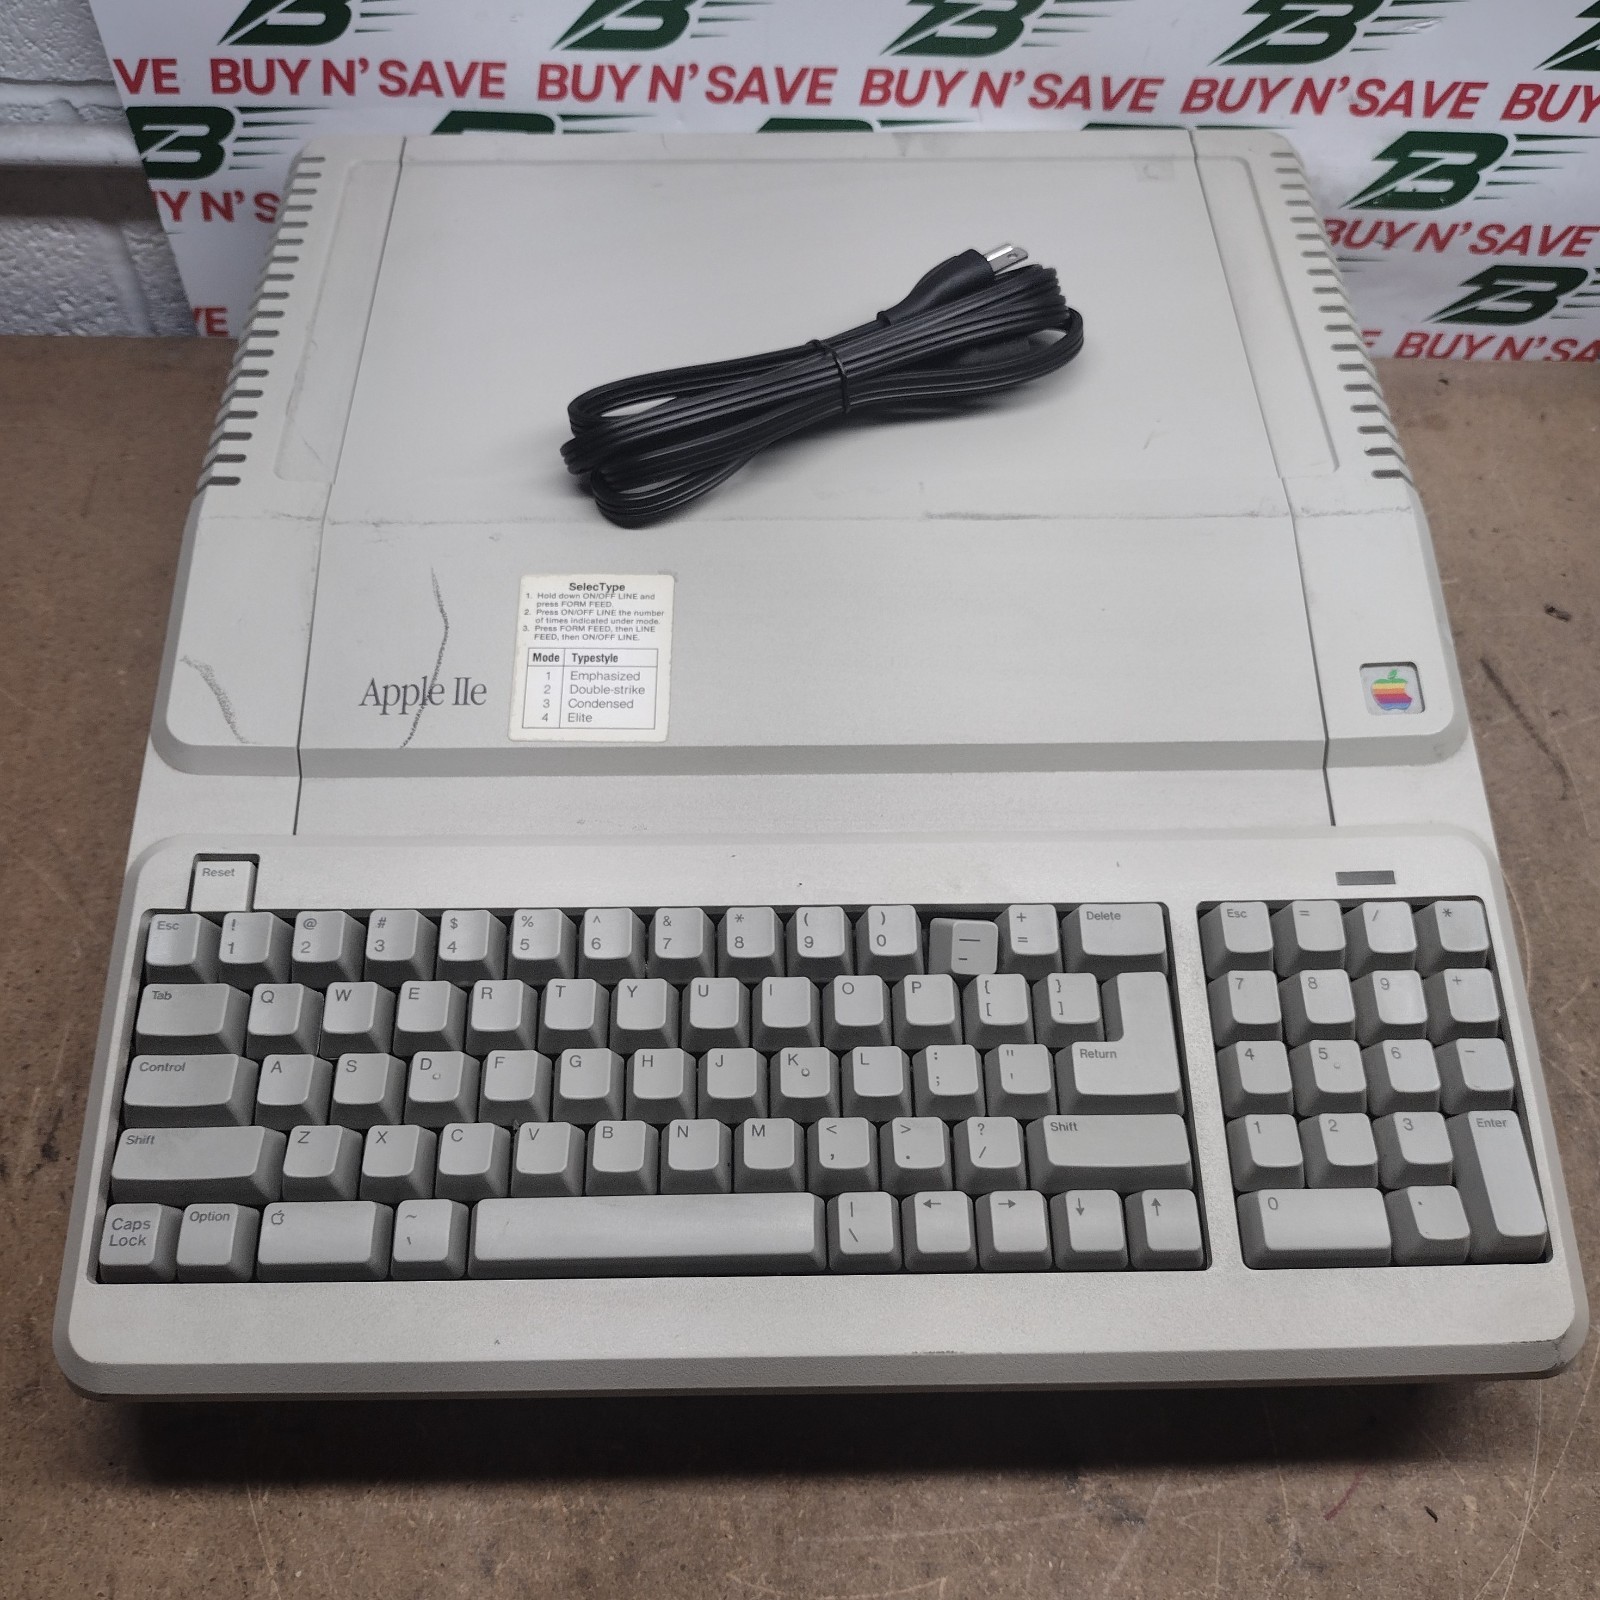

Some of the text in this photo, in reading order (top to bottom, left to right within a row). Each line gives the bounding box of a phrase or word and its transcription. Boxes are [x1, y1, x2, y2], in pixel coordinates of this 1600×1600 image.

[210, 58, 310, 95] BUY
[537, 64, 639, 102] BUY
[860, 68, 966, 107] BUY
[1179, 77, 1293, 114] BUY
[1393, 331, 1496, 361] BUY
[569, 582, 626, 594] SelecType
[532, 653, 618, 664] Mode Typestyle
[545, 671, 640, 683] 1 Emphasized
[358, 676, 445, 715] Apple
[544, 684, 645, 695] 2 Double-strike
[543, 699, 634, 709] 3 Condensed
[541, 713, 593, 722] 4 Elite
[202, 868, 234, 877] Reset
[1086, 911, 1121, 920] Delete
[1227, 909, 1247, 918] Esc
[156, 920, 180, 931] Esc
[303, 918, 317, 930] @
[378, 917, 386, 928] #
[450, 917, 458, 929] $
[522, 916, 534, 927] %
[663, 916, 671, 926] &
[375, 940, 385, 952] 3
[520, 939, 529, 950] 5
[591, 938, 601, 950] 6
[663, 938, 672, 949] 7
[735, 936, 744, 948] 8
[804, 936, 814, 948] 9
[877, 934, 886, 947] 0
[227, 942, 235, 954] 1
[301, 941, 311, 953] 2
[447, 941, 457, 953] 4
[912, 981, 921, 993] P
[1235, 978, 1243, 989] 7
[1308, 977, 1318, 989] 8
[1380, 978, 1390, 990] 9
[152, 991, 172, 1000] Tab
[261, 990, 274, 1003] Q
[336, 989, 352, 1001] W
[409, 987, 420, 1000] E
[481, 987, 492, 999] R
[556, 985, 566, 997] T
[627, 986, 637, 997] Y
[699, 985, 708, 997] U
[861, 1053, 869, 1065] L
[1080, 1049, 1117, 1058] Return
[1245, 1048, 1254, 1060] 4
[1319, 1048, 1328, 1060] 5
[1391, 1047, 1401, 1059] 6
[420, 1058, 432, 1070] D
[495, 1057, 505, 1068] F
[570, 1055, 581, 1067] G
[642, 1055, 653, 1067] H
[716, 1055, 723, 1067] J
[788, 1054, 798, 1065] K
[140, 1062, 186, 1072] Control
[271, 1061, 282, 1073] A
[346, 1060, 357, 1072] S
[1050, 1122, 1078, 1131] Shift
[1254, 1121, 1261, 1133] 1
[1328, 1119, 1338, 1132] 2
[1403, 1118, 1414, 1131] 3
[1476, 1118, 1506, 1127] Enter
[529, 1128, 539, 1140] V
[603, 1126, 613, 1138] B
[678, 1125, 688, 1137] N
[752, 1125, 765, 1136] M
[977, 1123, 985, 1135] ?
[126, 1135, 155, 1145] Shift
[298, 1131, 310, 1143] Z
[376, 1131, 388, 1143] X
[451, 1129, 463, 1142] C
[1268, 1197, 1278, 1210] 0
[188, 1210, 231, 1223] Option
[112, 1218, 150, 1232] Caps
[109, 1231, 146, 1246] Lock
